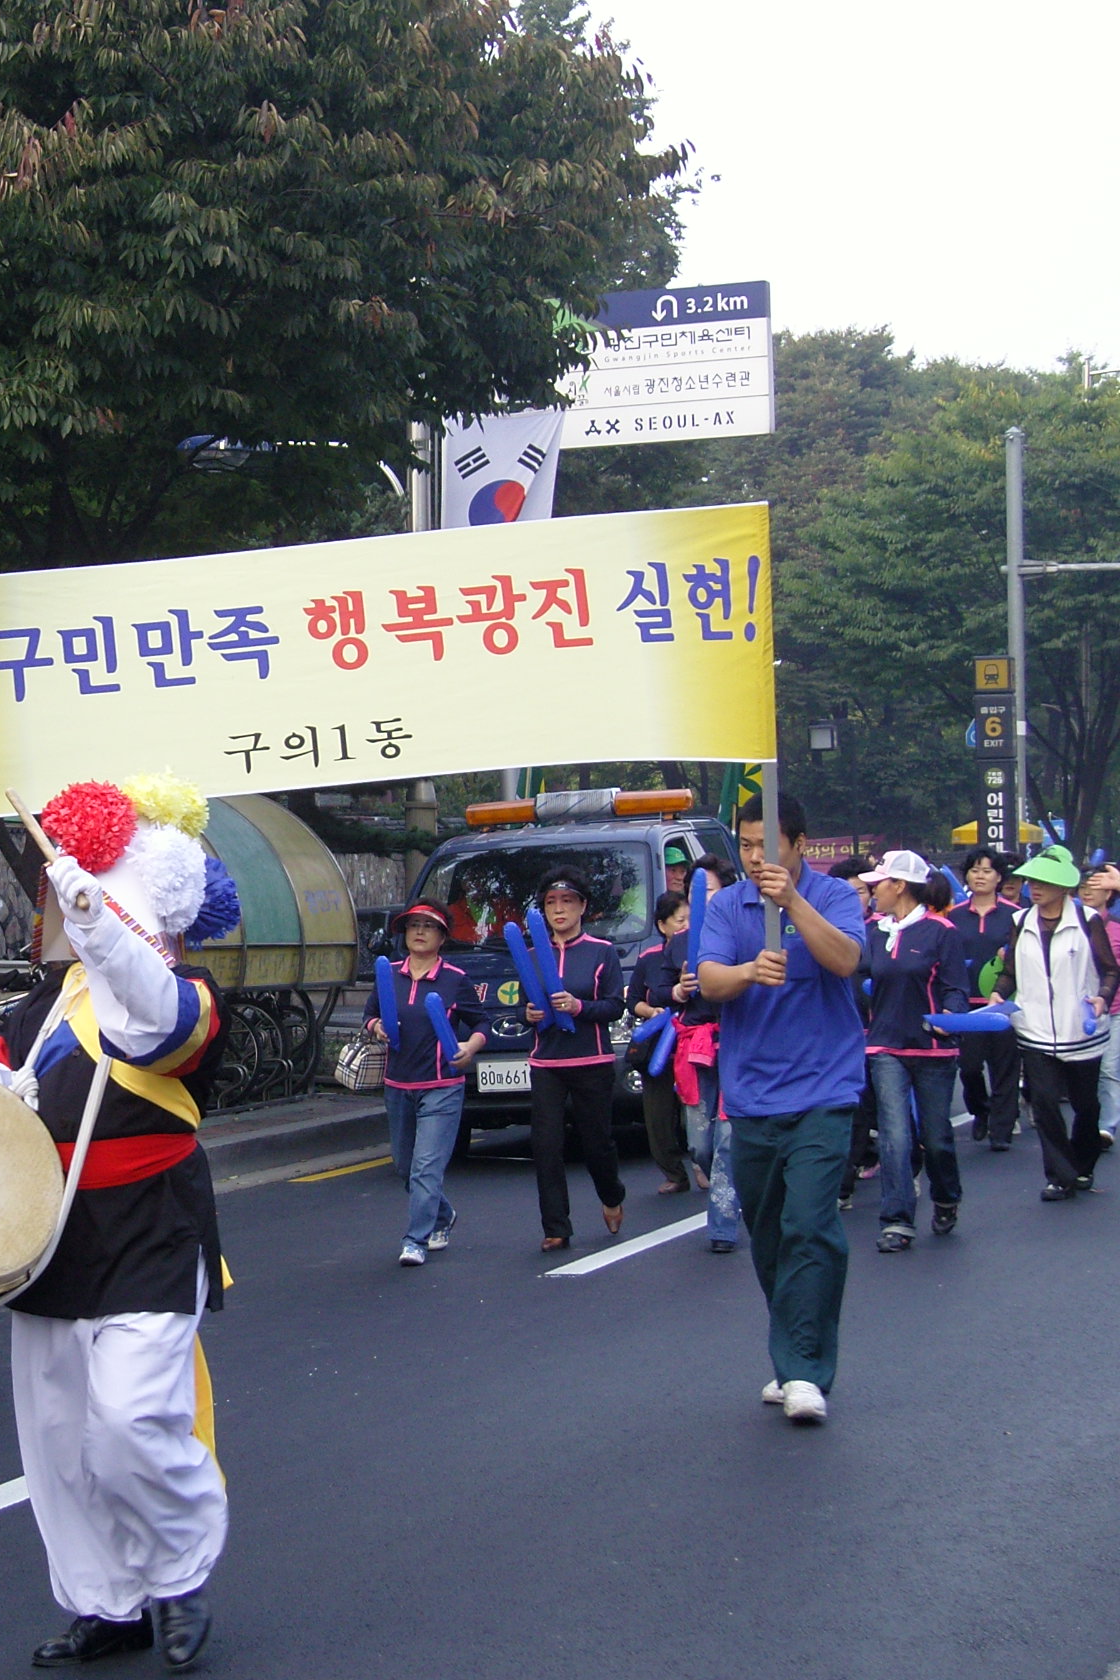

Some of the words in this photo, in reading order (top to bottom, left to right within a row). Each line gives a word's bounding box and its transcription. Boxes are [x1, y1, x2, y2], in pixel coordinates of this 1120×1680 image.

[604, 351, 659, 363] Gwangjin
[666, 348, 705, 358] Sports
[712, 345, 752, 355] Center
[604, 383, 640, 397] 서울시립
[644, 371, 750, 394] 광진청소년수련관
[635, 410, 735, 431] SEOUL-AX
[303, 568, 594, 670] 행복광진
[617, 555, 761, 643] 실현!
[985, 716, 1002, 737] 6
[983, 739, 1004, 748] EXIT
